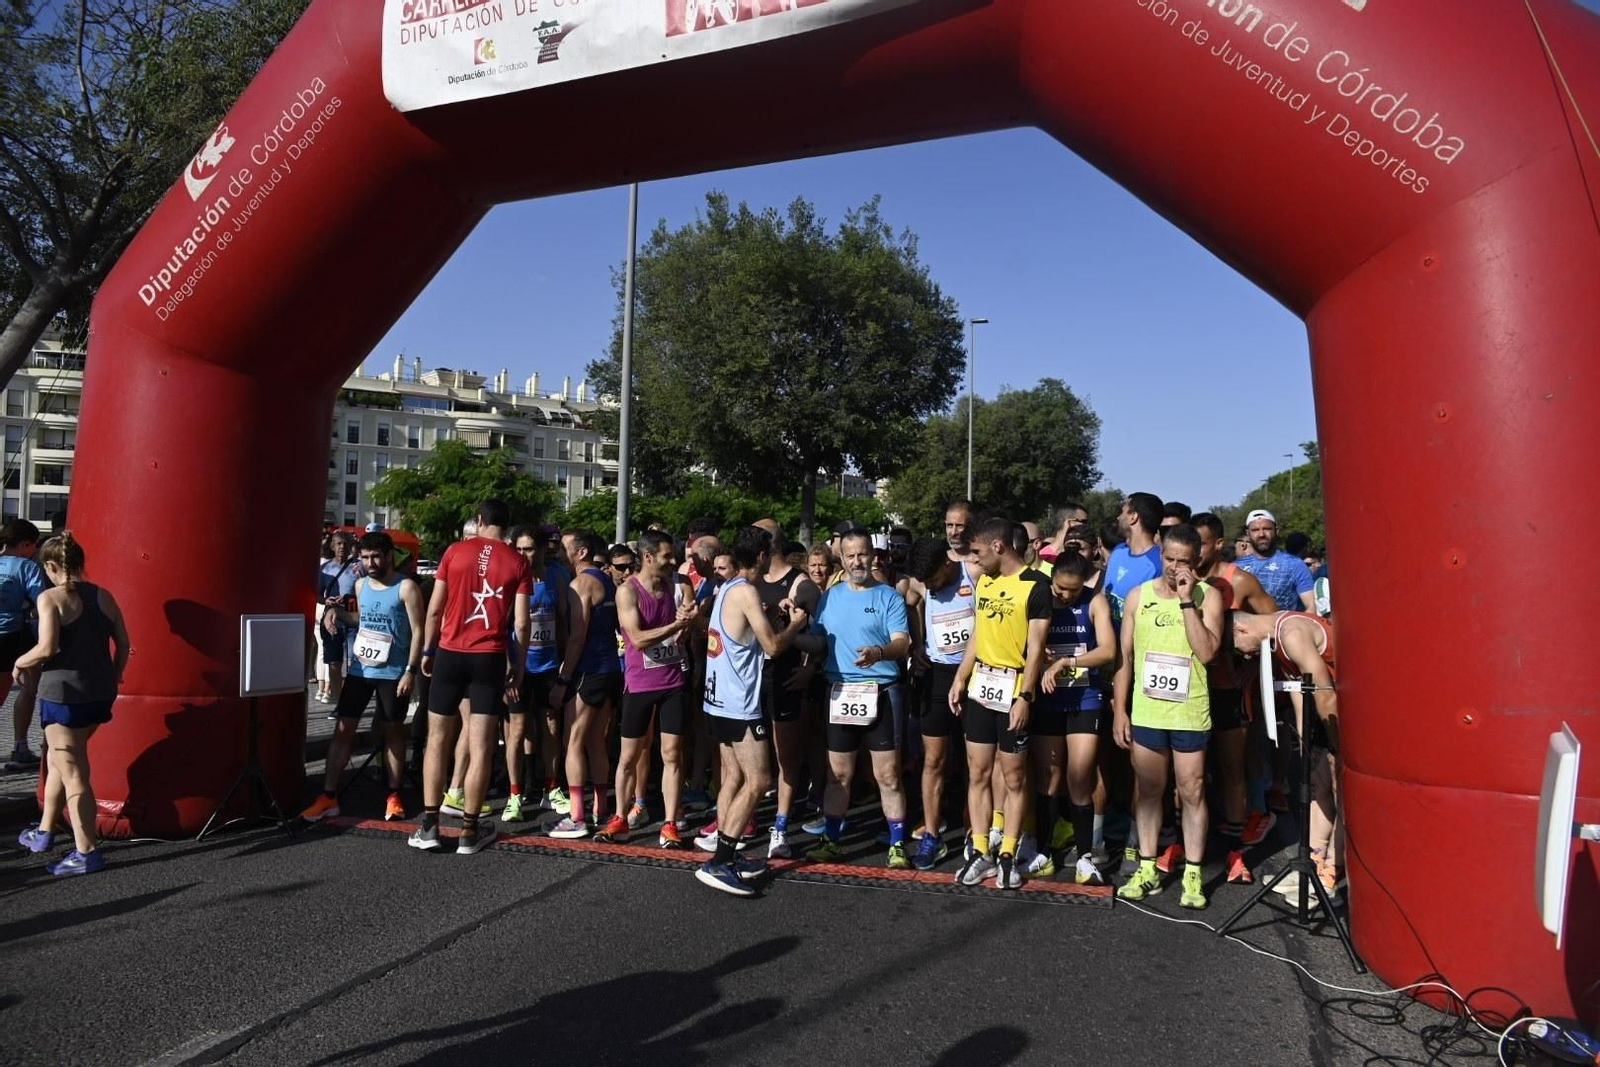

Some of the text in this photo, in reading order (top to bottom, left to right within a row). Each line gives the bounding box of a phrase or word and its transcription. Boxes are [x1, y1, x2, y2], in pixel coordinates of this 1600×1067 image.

[401, 0, 537, 45] DIPUTACIÓN DE
[448, 69, 486, 84] Diputación
[1262, 21, 1309, 62] de
[1316, 50, 1465, 165] Córdoba
[1181, 20, 1209, 45] de
[1210, 39, 1307, 111] Juventud
[1304, 104, 1326, 125] y
[1326, 113, 1429, 194] Deportes
[138, 77, 326, 307] Diputación de Córdoba
[155, 96, 342, 321] Delegación de Juventud y Deportes
[942, 629, 969, 645] 356
[1049, 625, 1086, 633] TASIERRA
[359, 646, 381, 659] 307
[653, 645, 673, 659] 370
[1149, 674, 1179, 691] 399
[979, 685, 1003, 702] 364
[841, 702, 868, 717] 363
